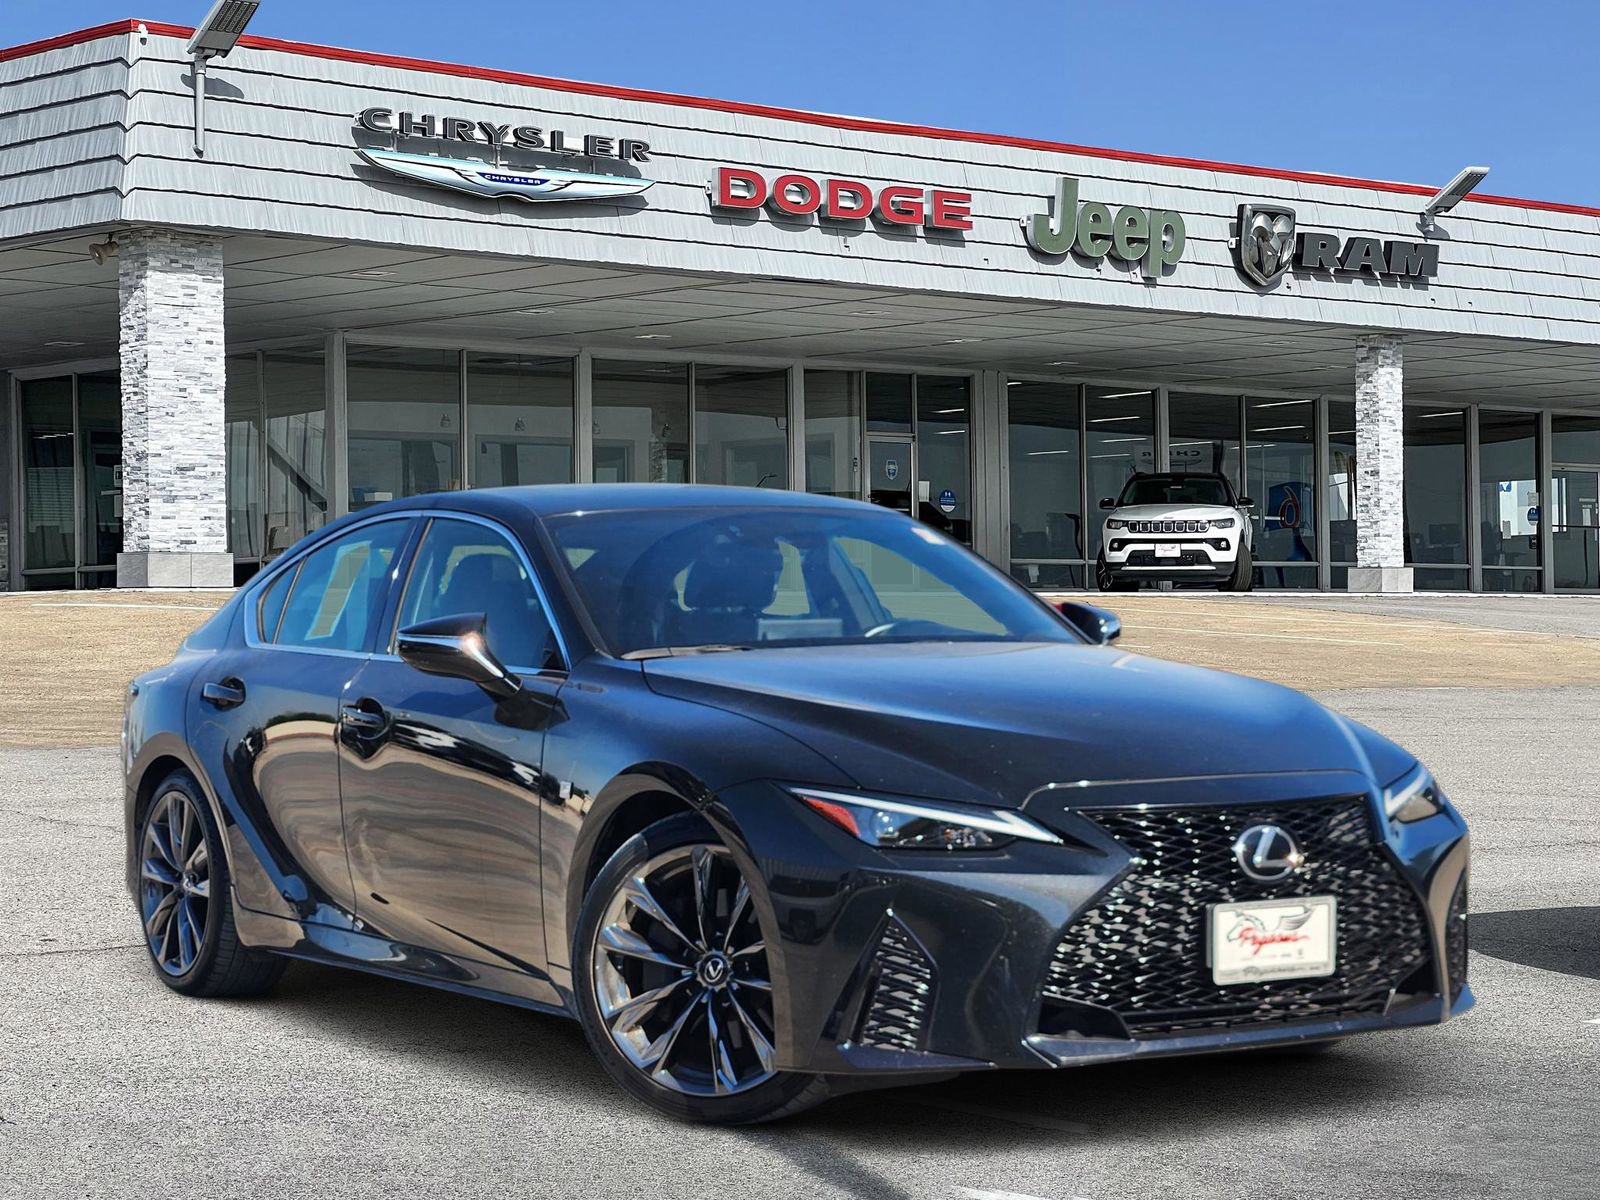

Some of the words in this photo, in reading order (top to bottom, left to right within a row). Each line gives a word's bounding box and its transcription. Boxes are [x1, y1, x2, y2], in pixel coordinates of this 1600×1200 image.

[358, 107, 651, 162] CHRYSLER
[484, 174, 541, 184] CHRYSLER
[713, 167, 973, 230] DODGE
[1028, 177, 1186, 277] Jeep
[1298, 232, 1439, 277] RAM
